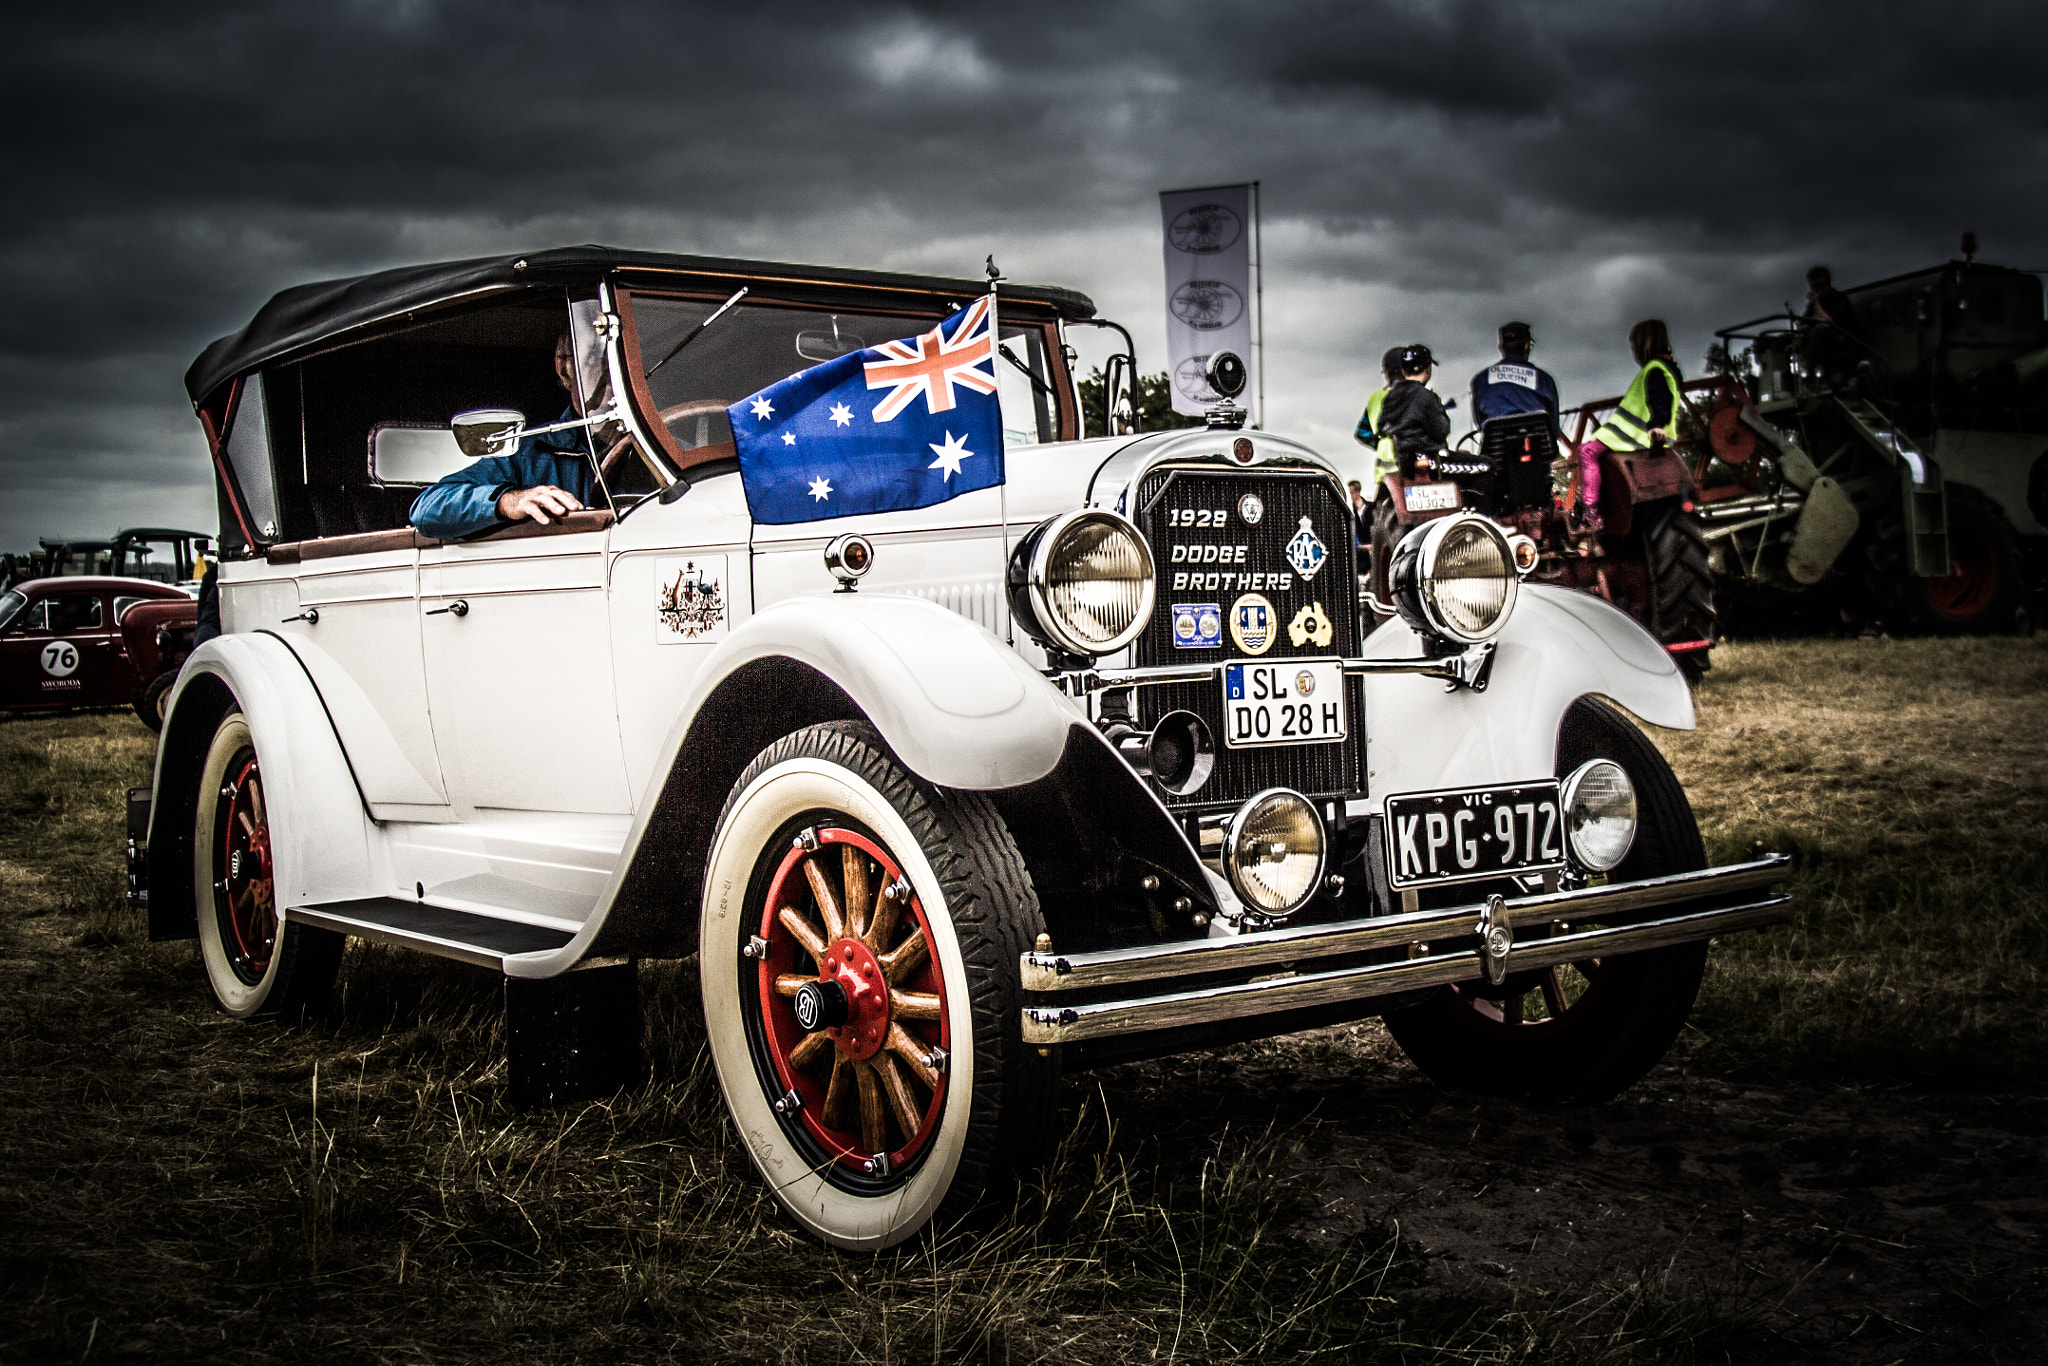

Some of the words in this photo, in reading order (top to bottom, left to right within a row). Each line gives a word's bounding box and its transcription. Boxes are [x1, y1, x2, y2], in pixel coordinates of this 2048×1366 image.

[1497, 372, 1528, 384] QUERN
[1415, 488, 1430, 499] SL
[1169, 509, 1227, 527] 1928
[1171, 545, 1248, 563] DODGE
[1173, 572, 1293, 591] BROTHERS
[46, 648, 75, 669] 76
[1232, 686, 1240, 698] D
[1253, 668, 1287, 700] SL
[1236, 705, 1271, 739] DO
[1281, 703, 1313, 737] 28
[1322, 702, 1338, 734] H
[1463, 793, 1492, 807] VIC
